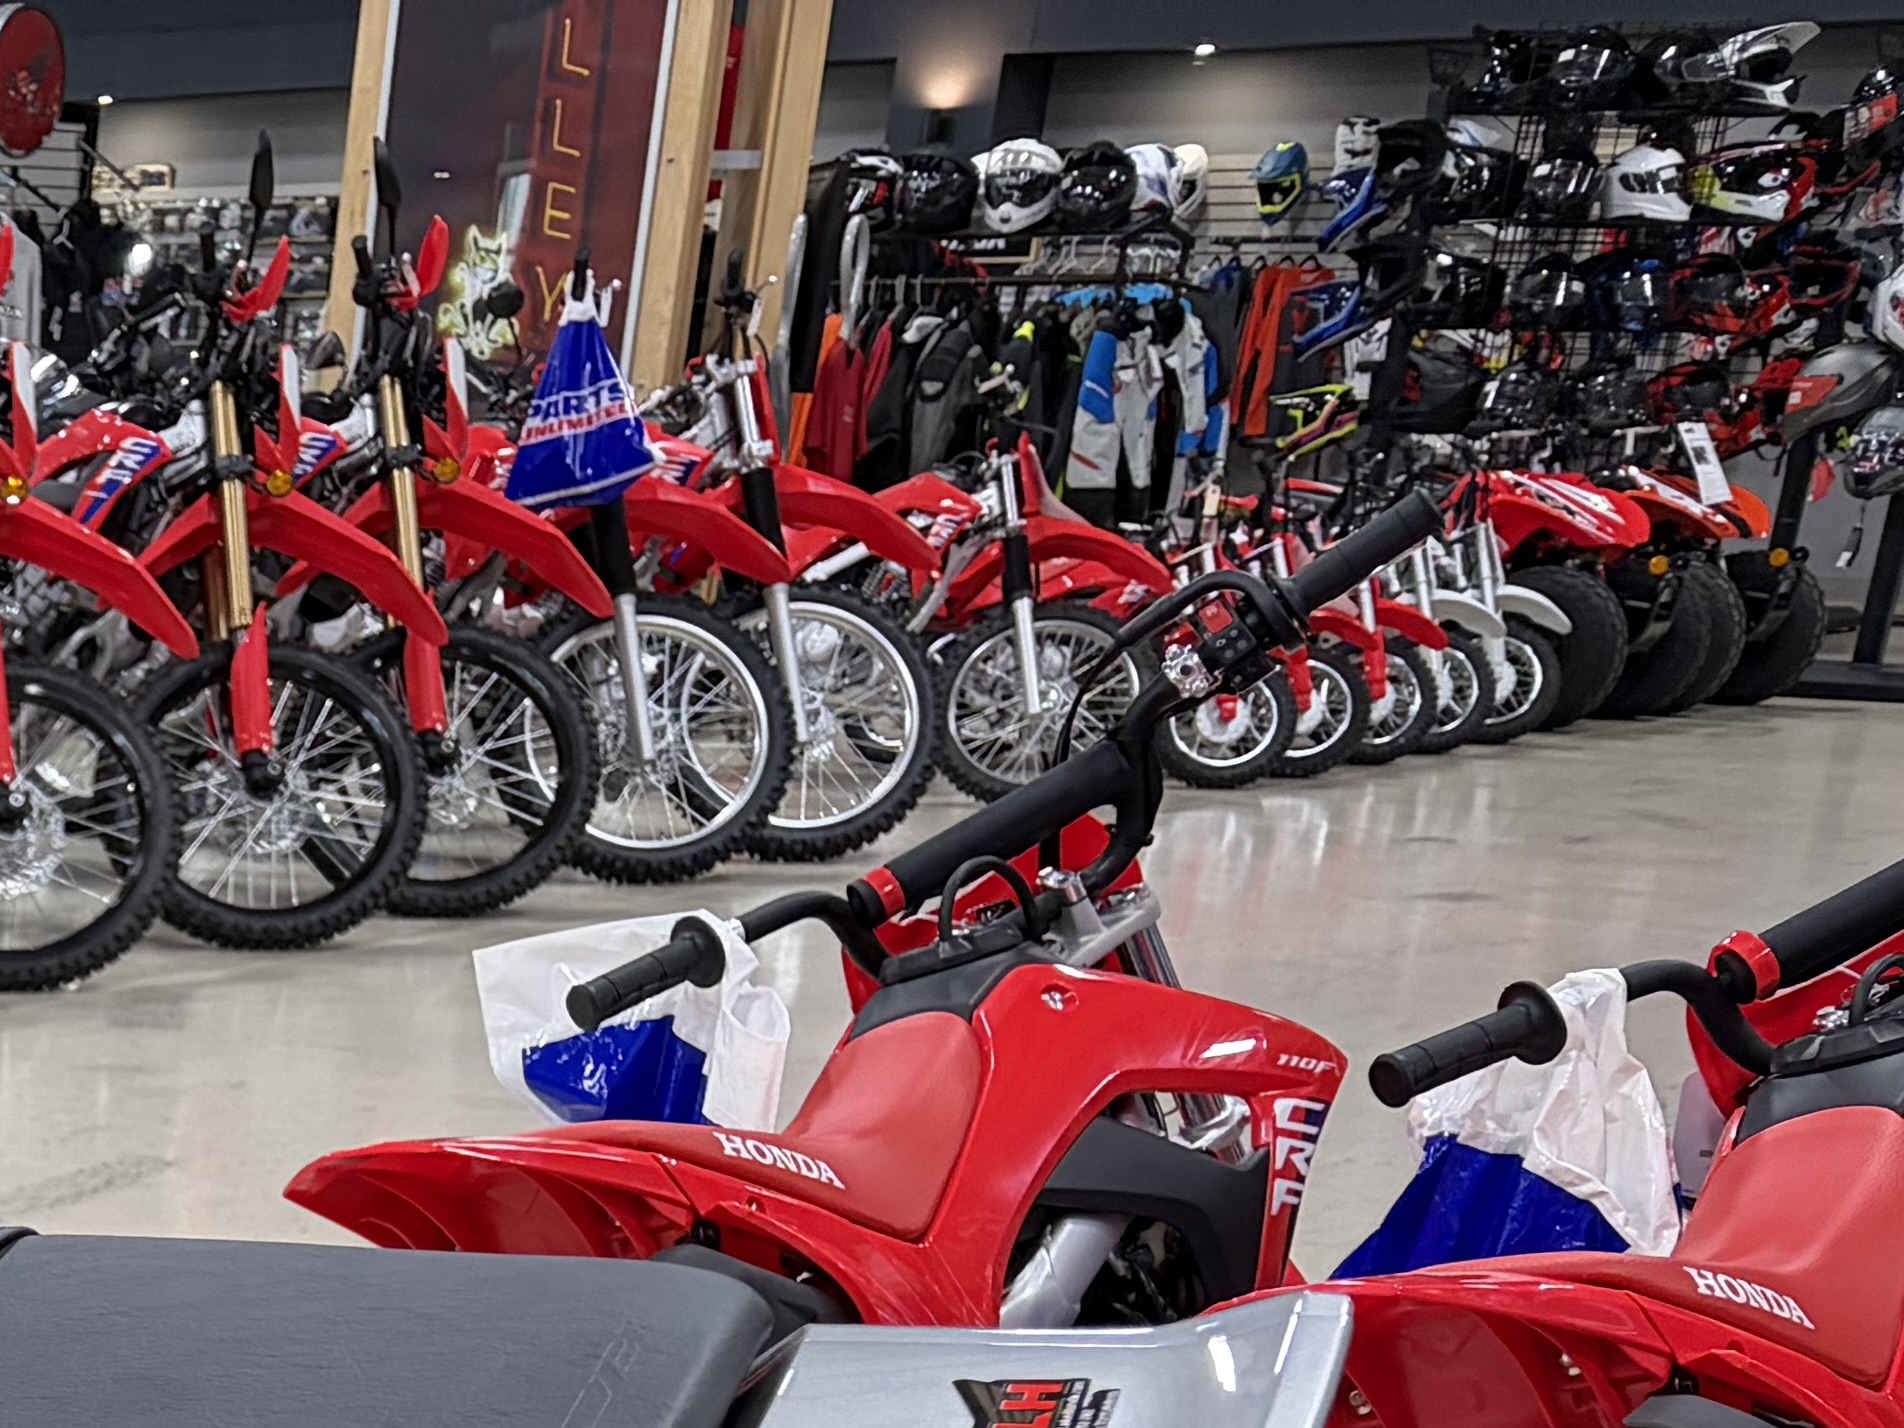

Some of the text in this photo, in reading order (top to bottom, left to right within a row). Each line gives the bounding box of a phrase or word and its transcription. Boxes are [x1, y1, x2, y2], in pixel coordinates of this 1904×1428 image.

[527, 383, 630, 422] PARTS
[1276, 1053, 1336, 1073] 110F
[712, 1130, 847, 1191] HONDA
[1270, 1097, 1326, 1217] CRF
[1682, 1265, 1816, 1330] HONDA
